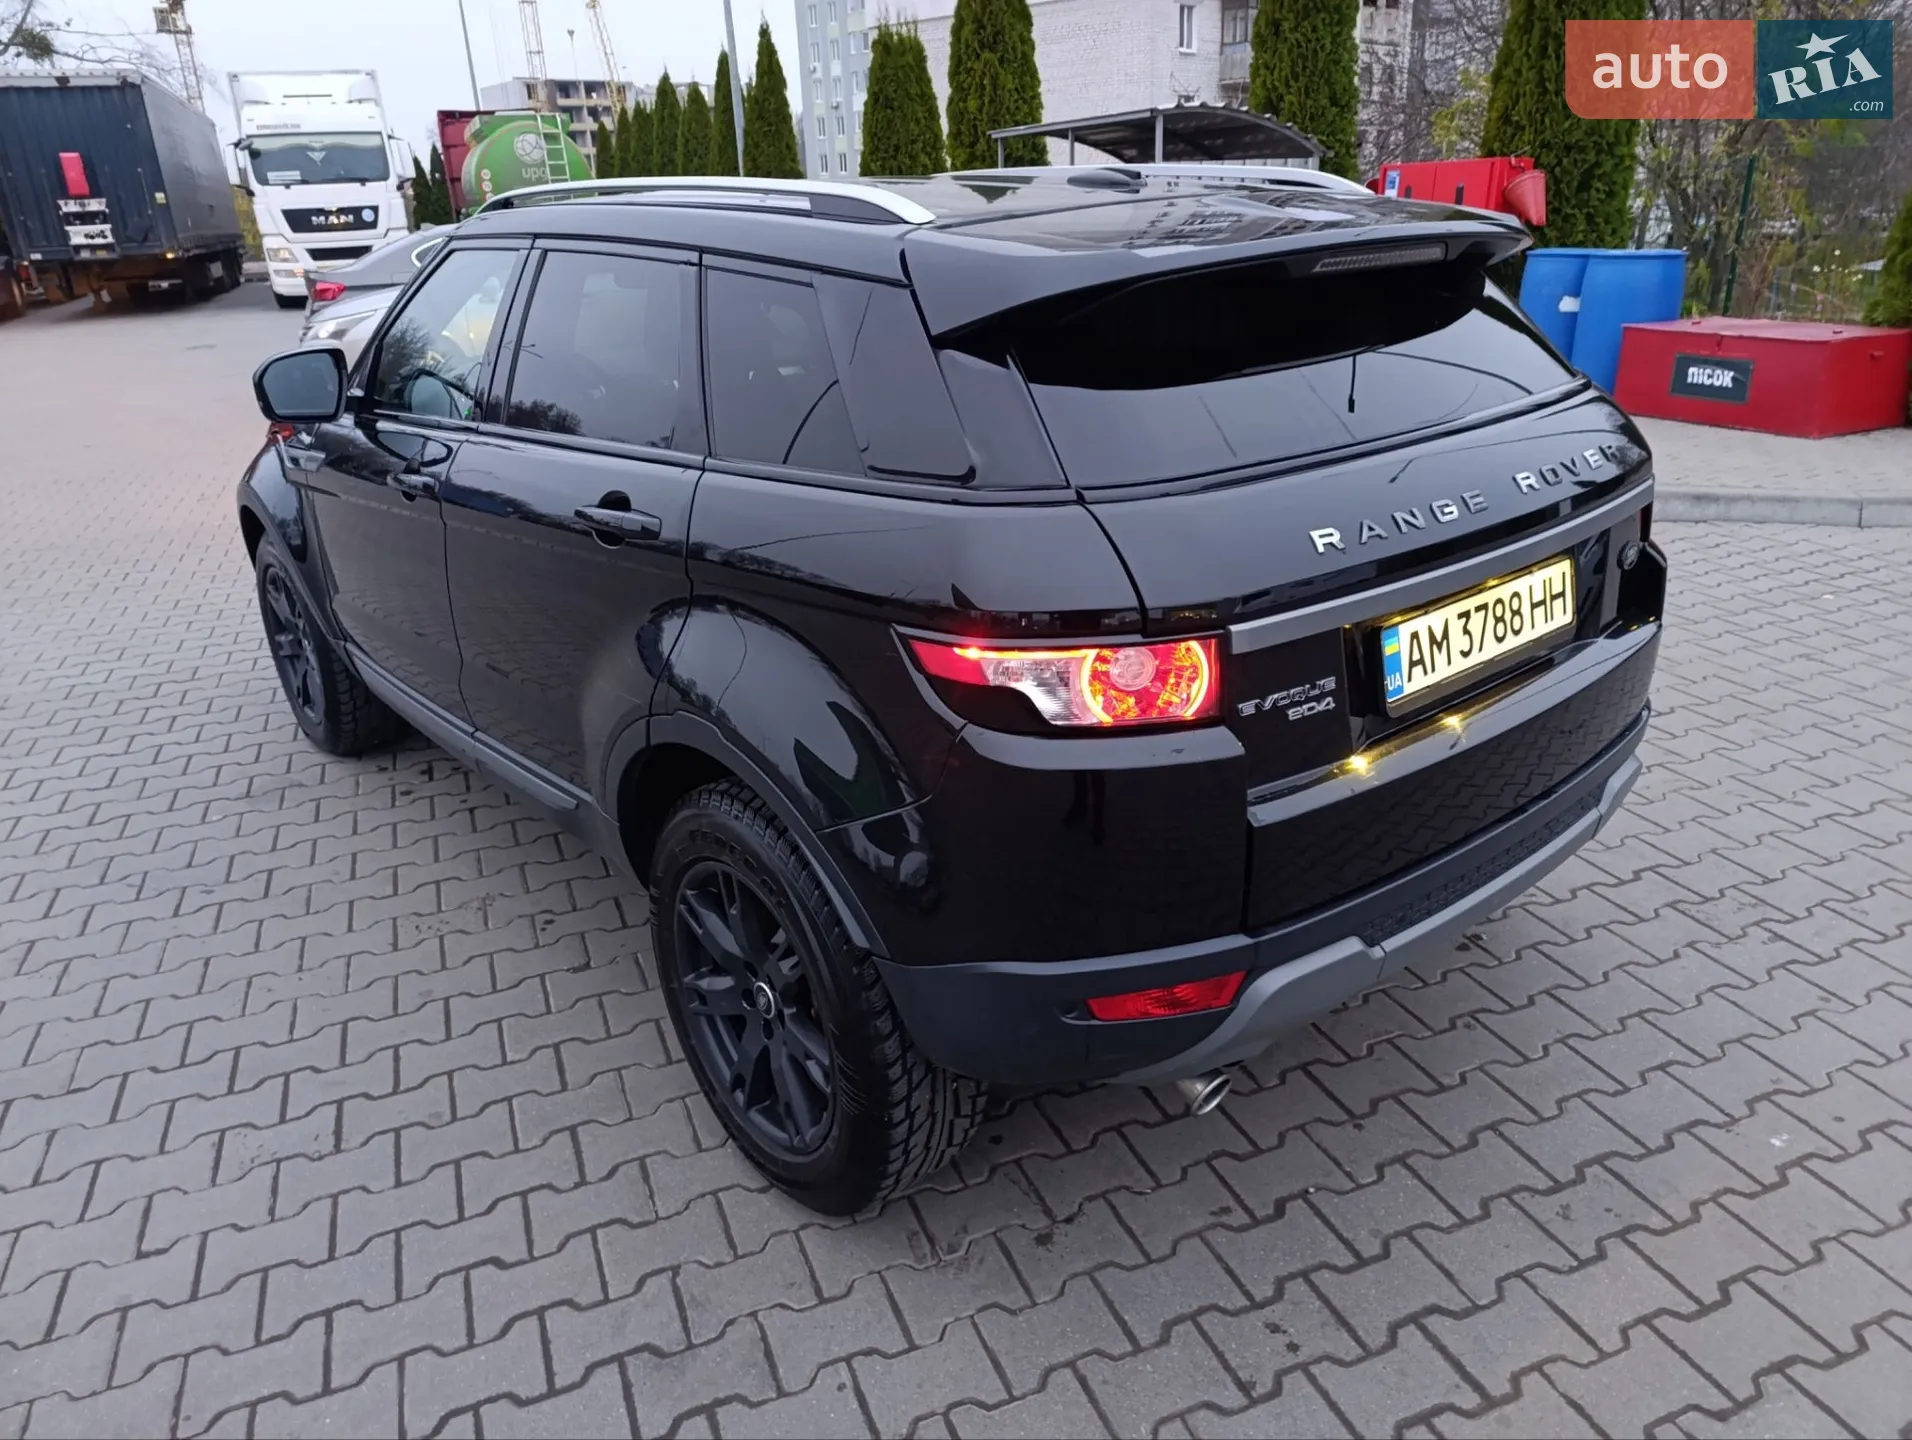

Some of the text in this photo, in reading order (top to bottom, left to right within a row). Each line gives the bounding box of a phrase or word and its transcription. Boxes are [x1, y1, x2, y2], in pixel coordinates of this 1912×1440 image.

[310, 213, 355, 226] MAN
[1686, 366, 1735, 388] ПІСОК
[1308, 442, 1621, 554] RANGE ROVER
[1406, 570, 1568, 684] AM 3788 HH
[1236, 675, 1337, 717] EVOQUE
[1386, 674, 1403, 691] UA
